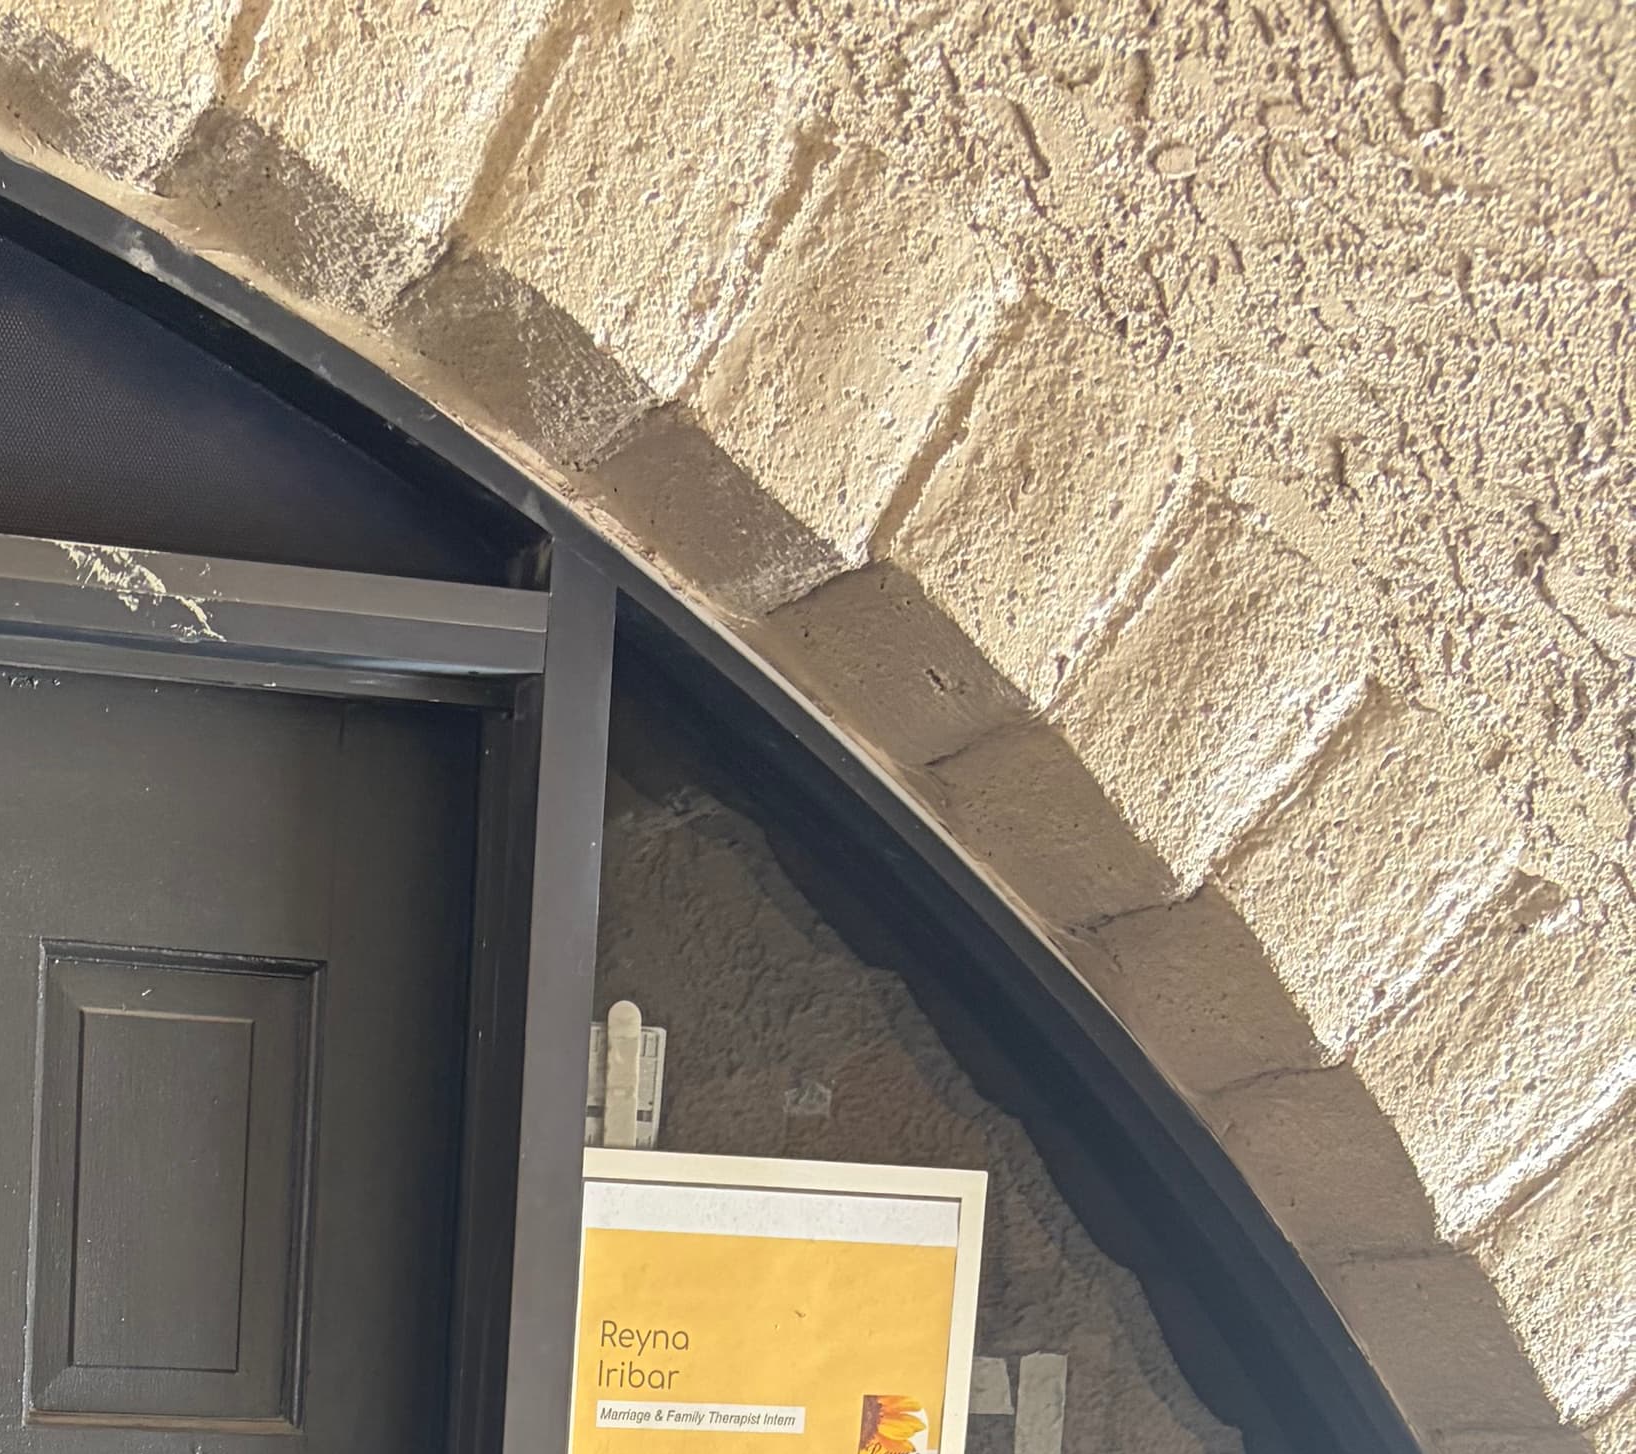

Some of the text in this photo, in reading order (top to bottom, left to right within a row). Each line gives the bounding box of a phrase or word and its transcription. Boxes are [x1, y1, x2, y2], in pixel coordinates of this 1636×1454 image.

[600, 1319, 690, 1357] Reyna
[597, 1359, 681, 1390] Iribar
[599, 1406, 797, 1427] Marriage & Family Therapist Intern
